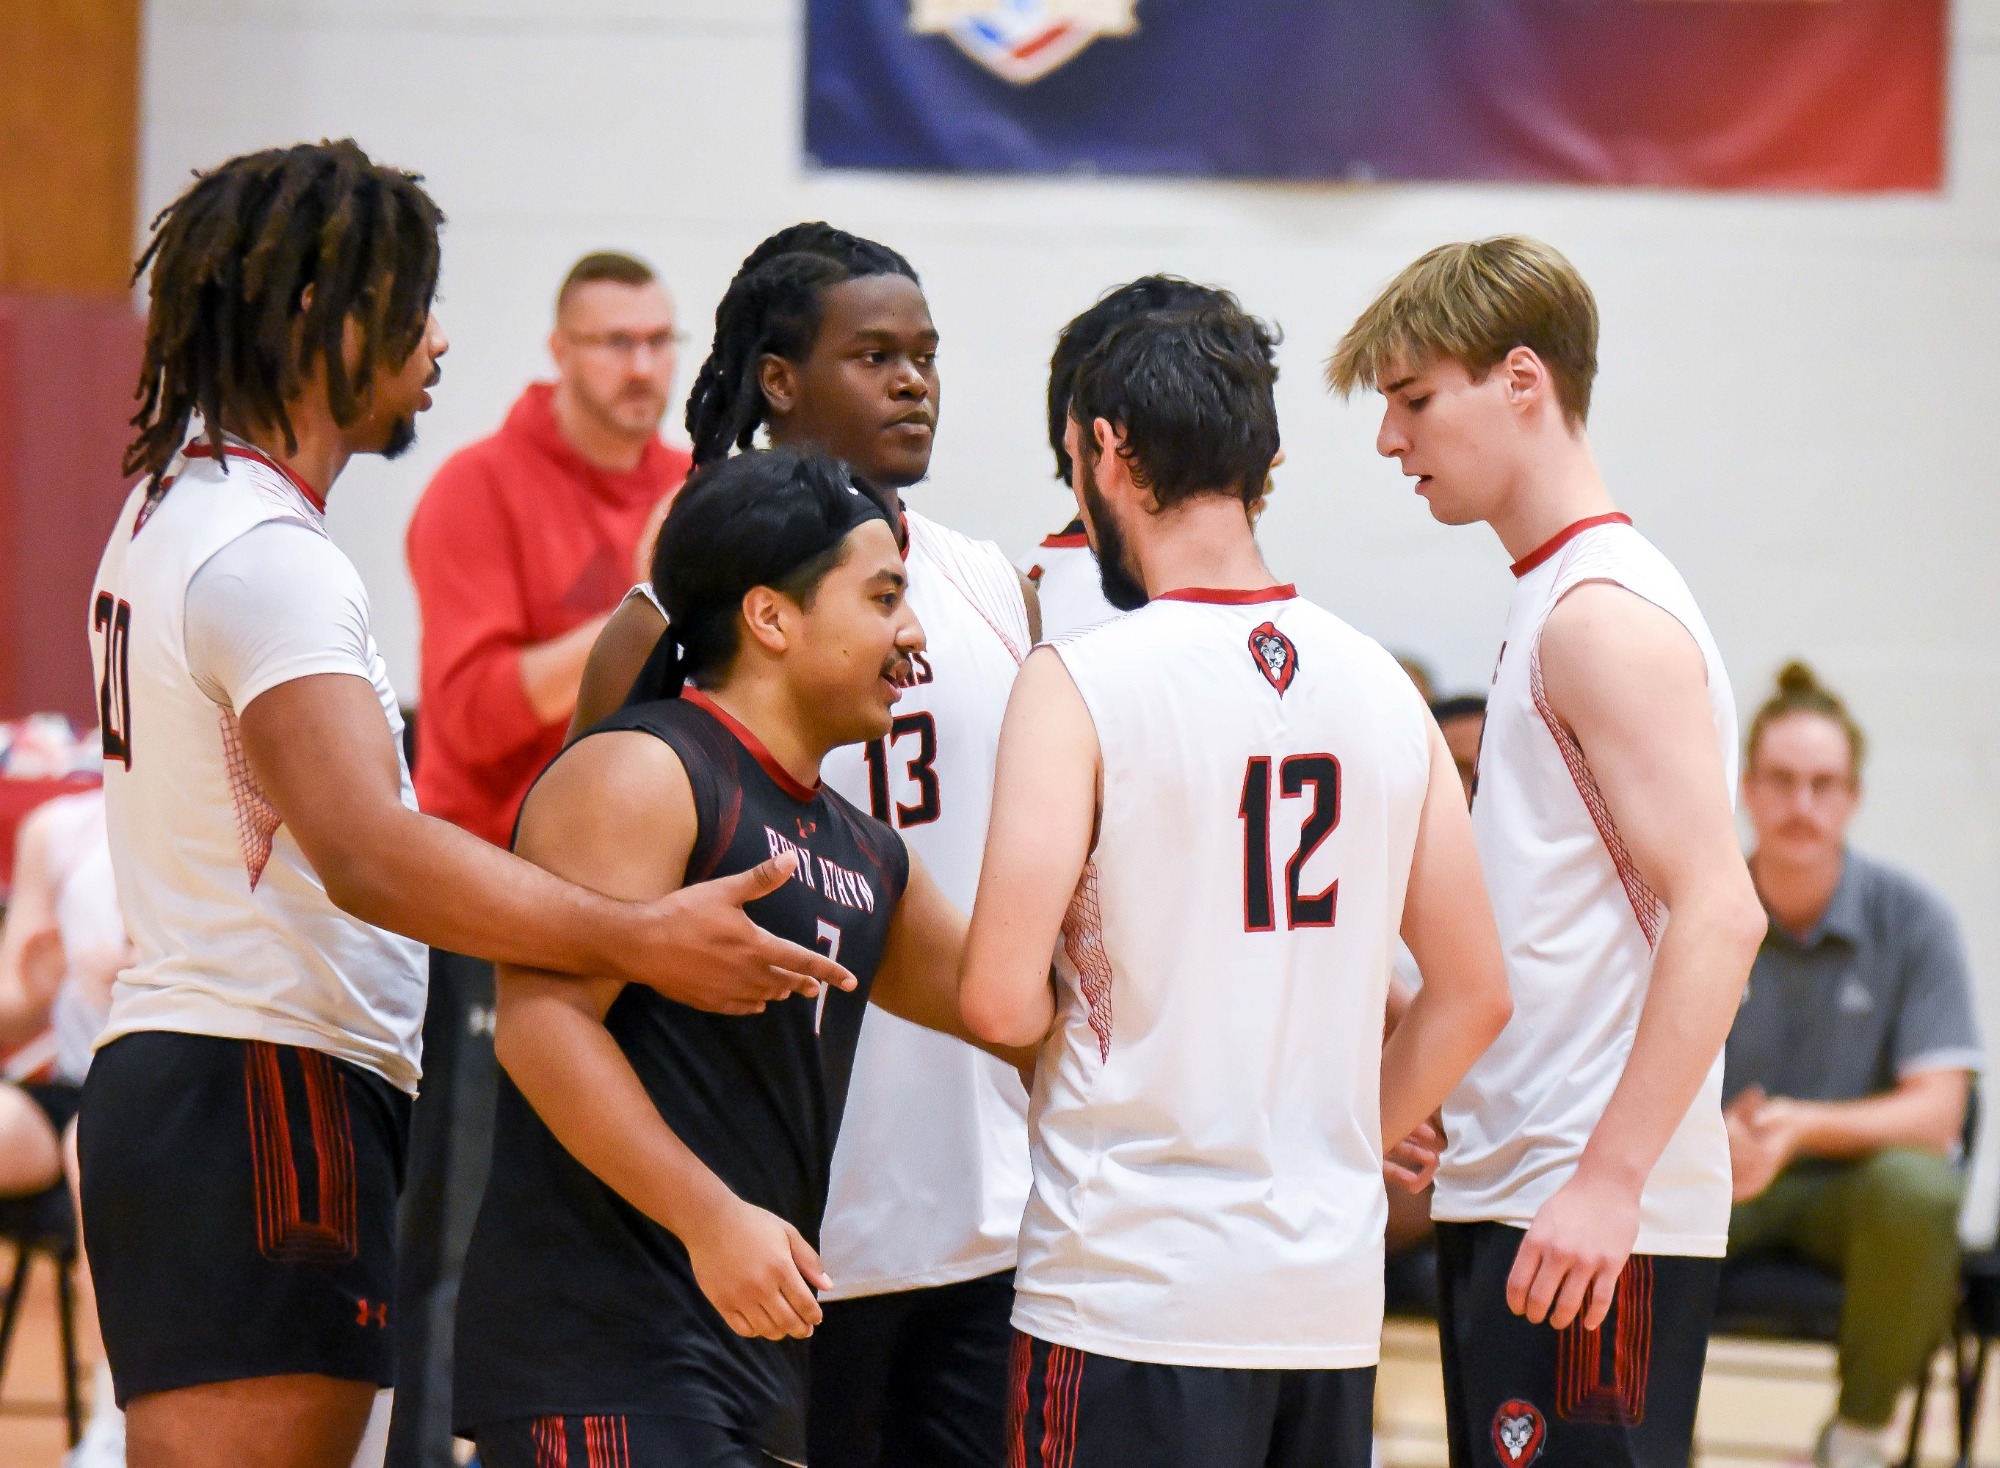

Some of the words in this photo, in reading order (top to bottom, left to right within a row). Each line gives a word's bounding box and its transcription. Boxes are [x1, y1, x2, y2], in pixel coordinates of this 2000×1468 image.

[95, 590, 132, 773] 20
[864, 710, 941, 829] 13
[817, 855, 875, 915] ATHYN
[1238, 752, 1342, 933] 12
[815, 916, 842, 1037] 7
